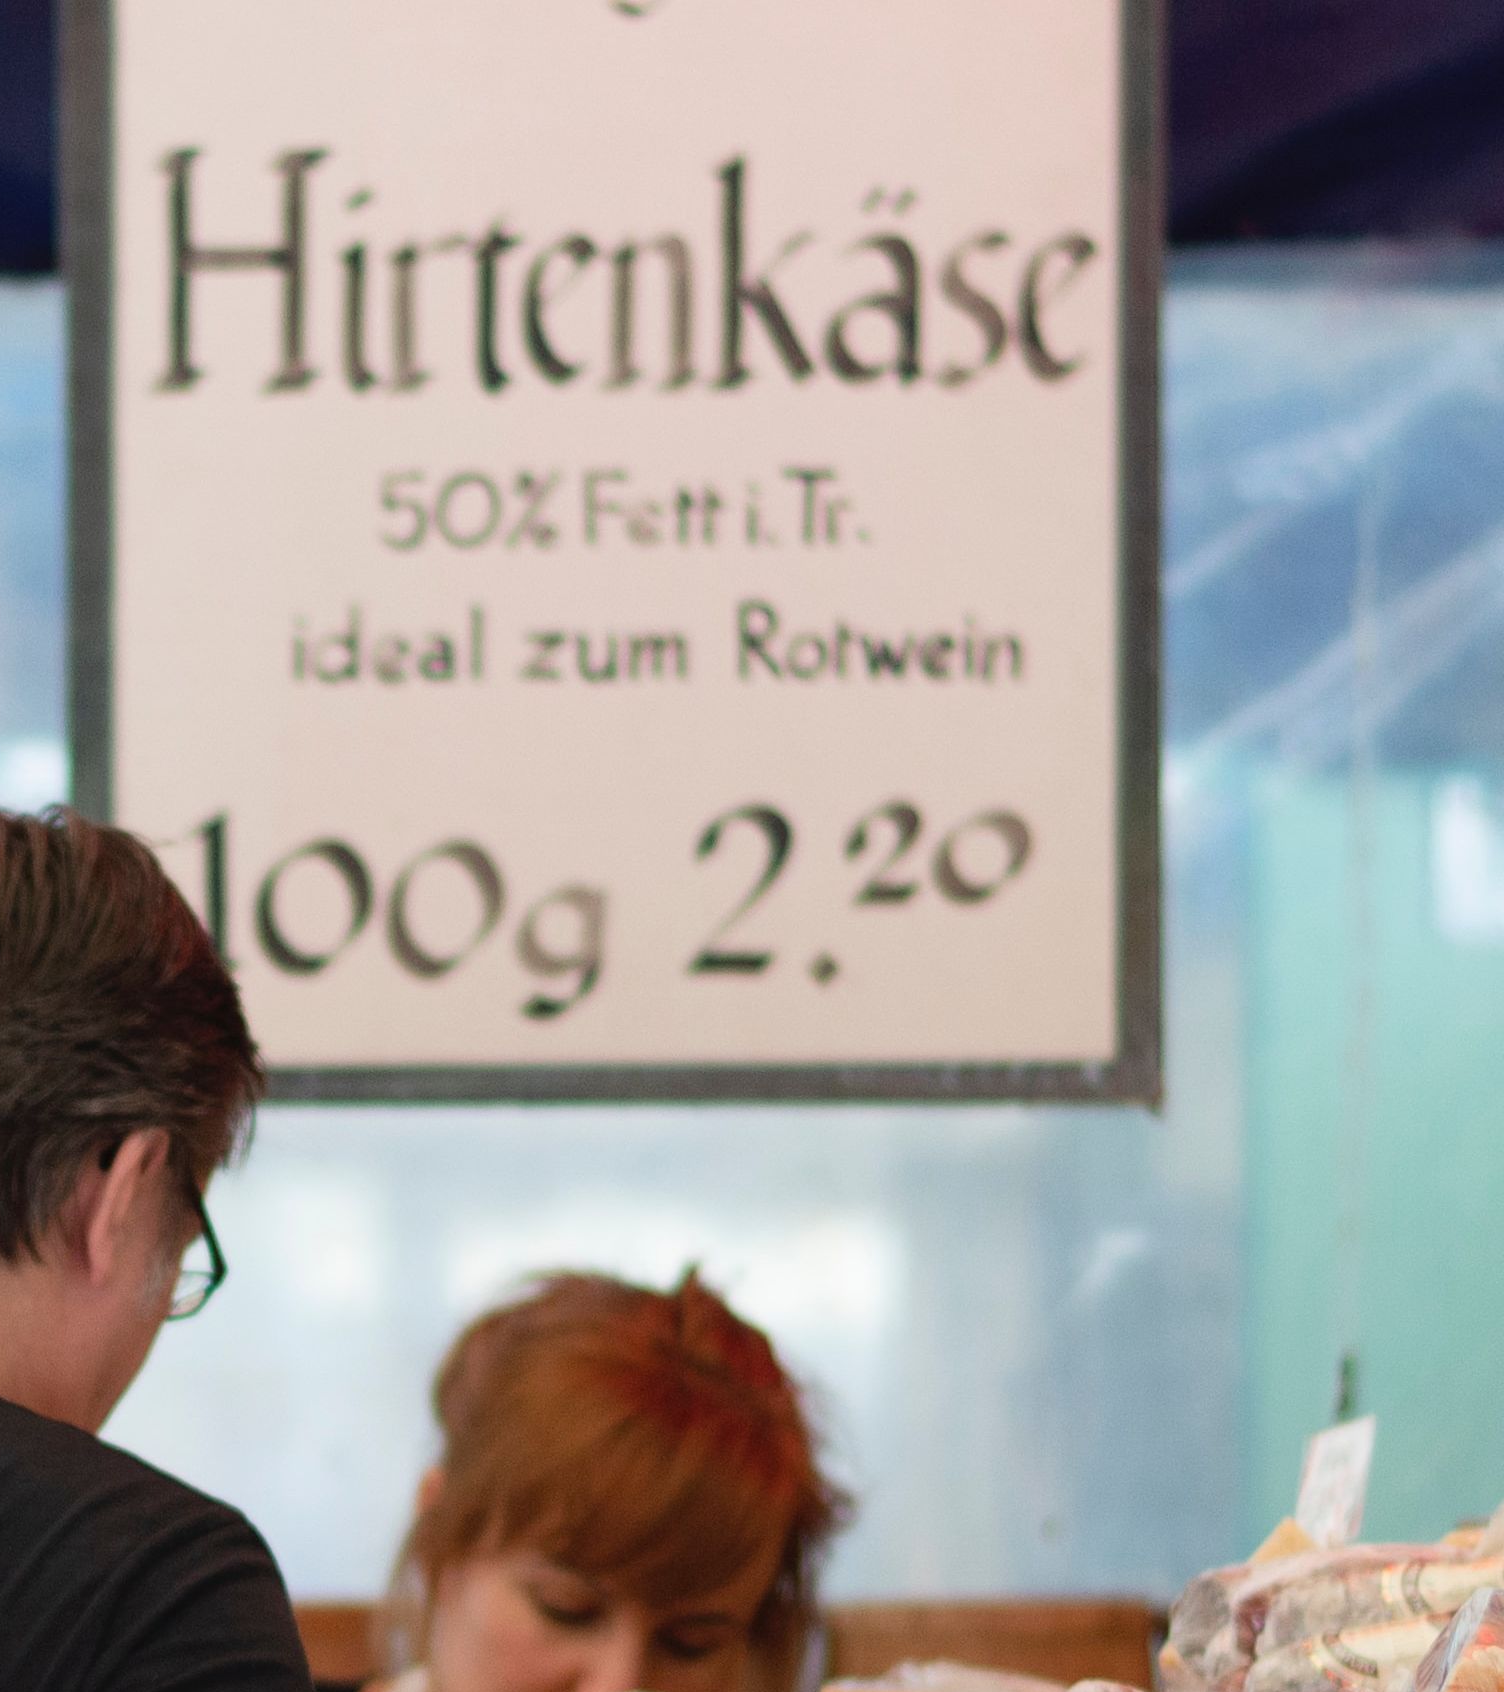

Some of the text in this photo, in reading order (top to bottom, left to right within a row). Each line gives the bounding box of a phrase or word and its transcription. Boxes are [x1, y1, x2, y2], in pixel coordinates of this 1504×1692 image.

[153, 145, 1104, 399] Hirtenkäse
[379, 468, 561, 552] 50%
[580, 468, 725, 547] Fett
[290, 597, 1028, 686] ideal zum Rotwein
[194, 798, 1036, 1021] 100g 2.20
